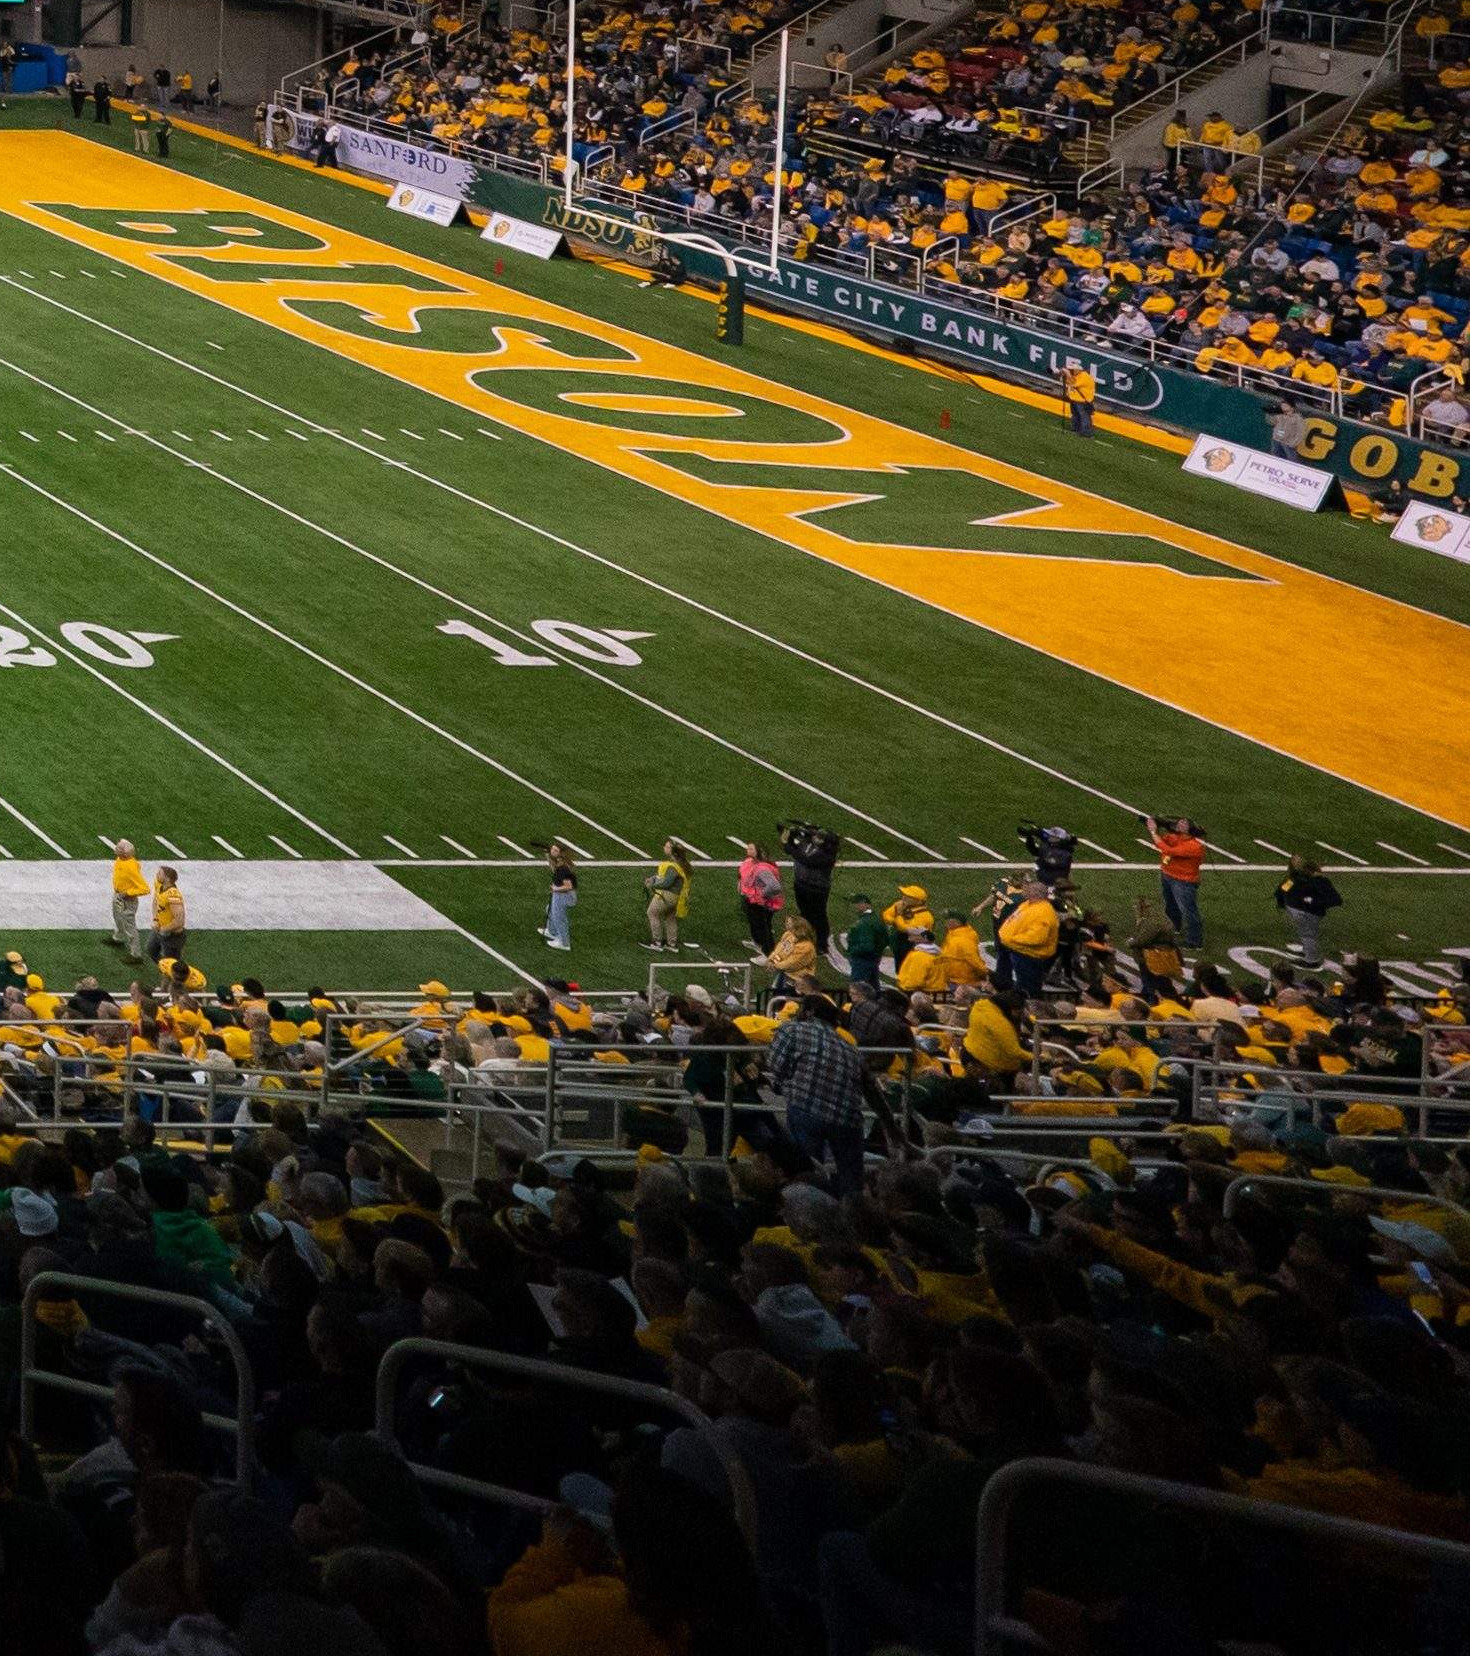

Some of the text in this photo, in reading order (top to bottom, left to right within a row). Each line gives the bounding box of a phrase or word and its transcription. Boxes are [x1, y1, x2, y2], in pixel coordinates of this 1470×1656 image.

[349, 136, 448, 176] SANFORD
[541, 196, 631, 244] NDSU
[746, 263, 820, 297] GATE
[833, 285, 906, 323] CITY
[920, 312, 1010, 355] BANK
[22, 201, 1284, 585] BISON
[432, 616, 646, 670] 10
